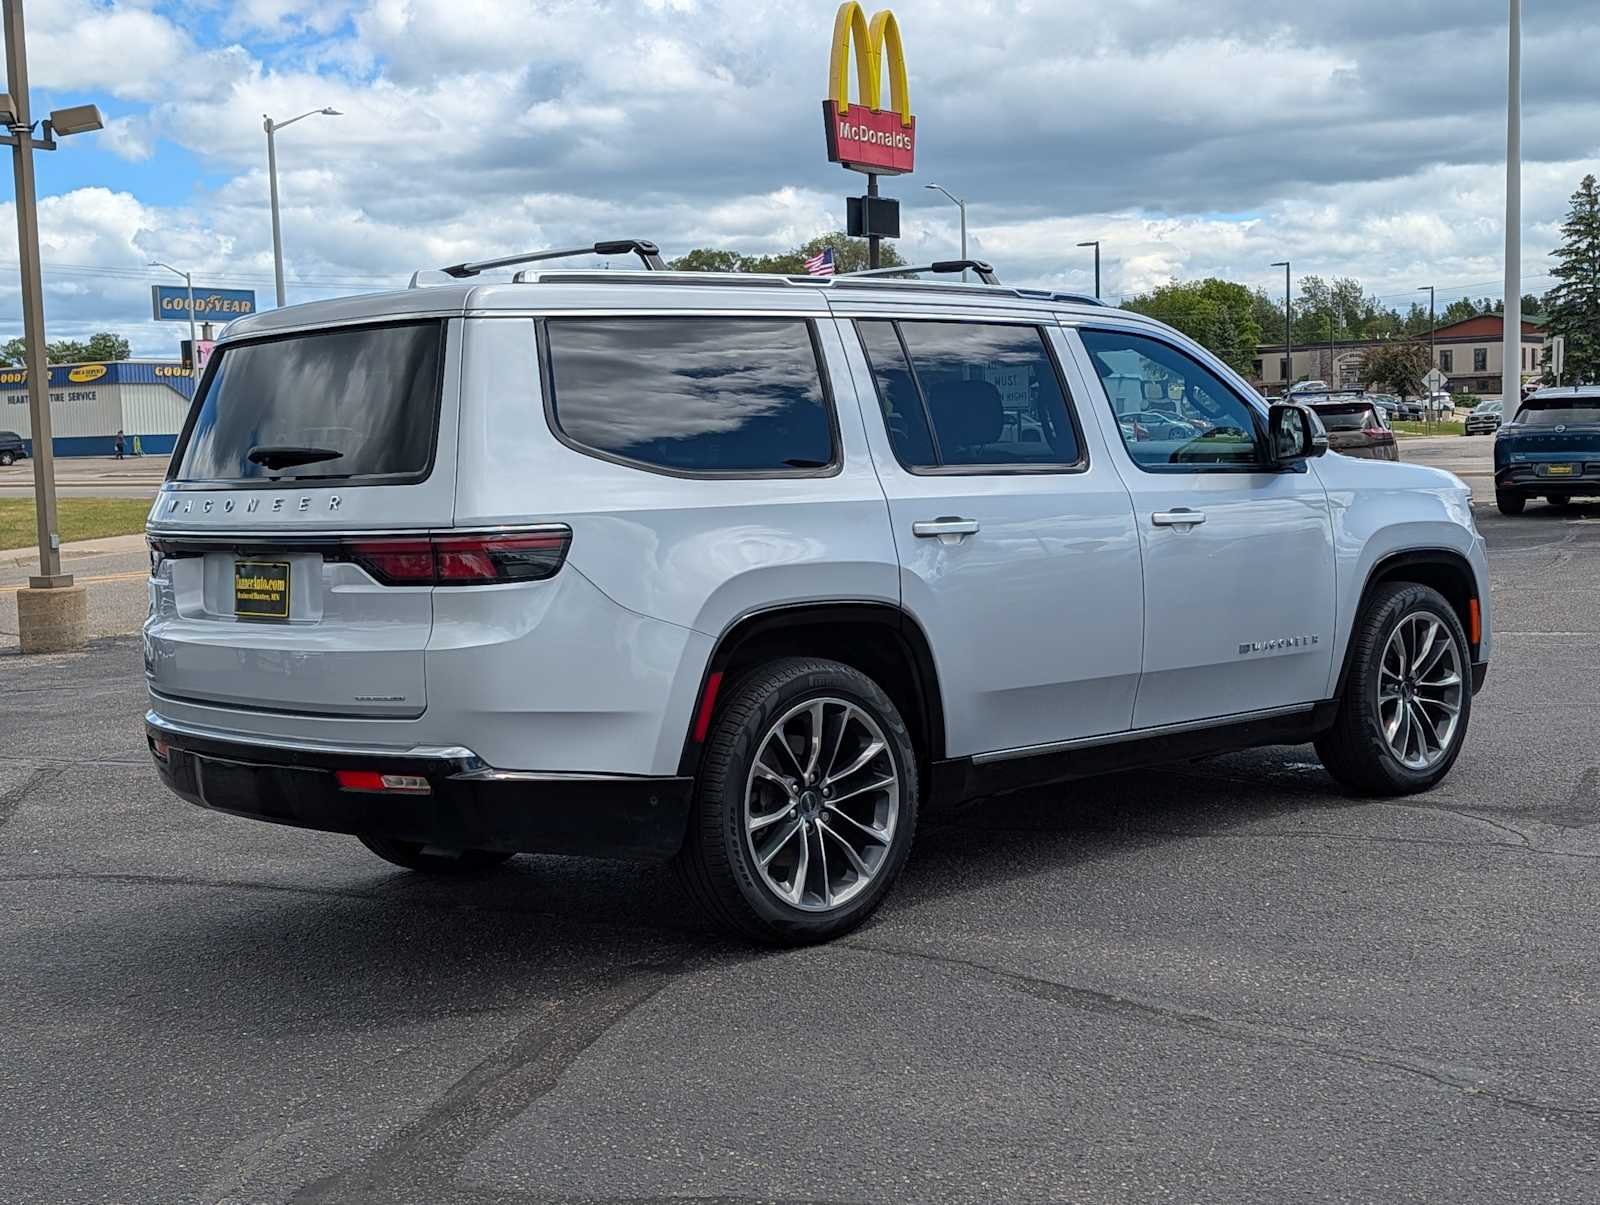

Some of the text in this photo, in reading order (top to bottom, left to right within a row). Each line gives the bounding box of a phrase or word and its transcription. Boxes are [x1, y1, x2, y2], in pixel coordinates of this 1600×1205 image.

[839, 122, 912, 149] McDonald's
[162, 297, 251, 313] GOODYEAR
[49, 393, 65, 402] TIRE
[68, 391, 96, 401] SERVICE
[168, 496, 342, 513] WAGONEER
